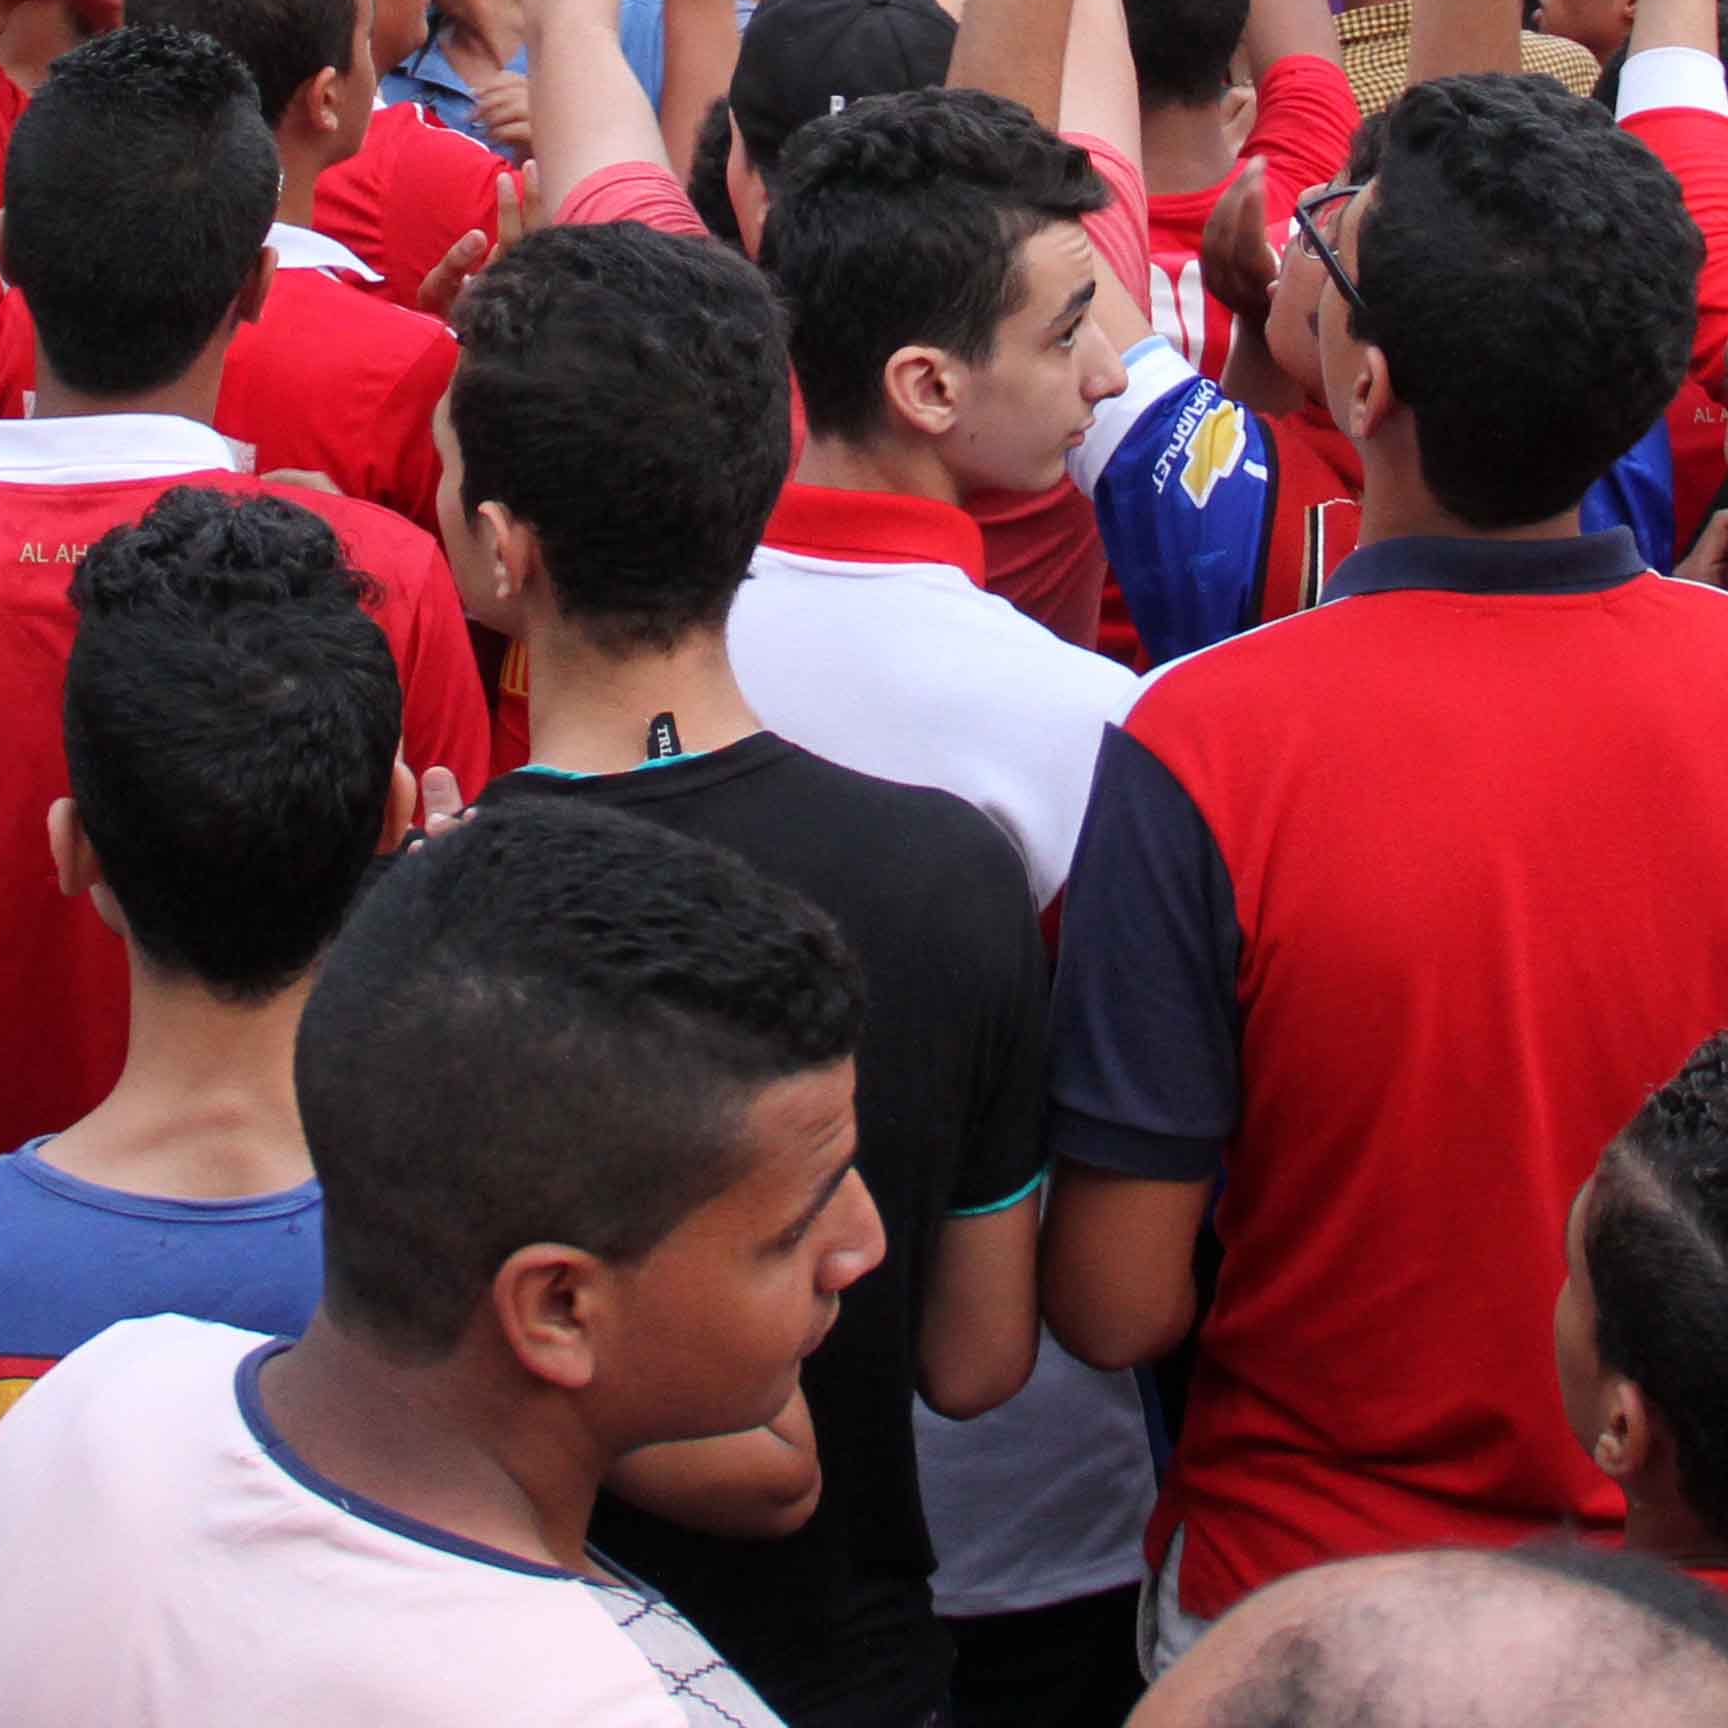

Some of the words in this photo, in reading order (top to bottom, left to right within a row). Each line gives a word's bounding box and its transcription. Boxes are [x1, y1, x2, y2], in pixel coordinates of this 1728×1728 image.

[1151, 378, 1218, 496] CHEVROLET
[18, 541, 49, 564] AL
[53, 541, 89, 565] AH
